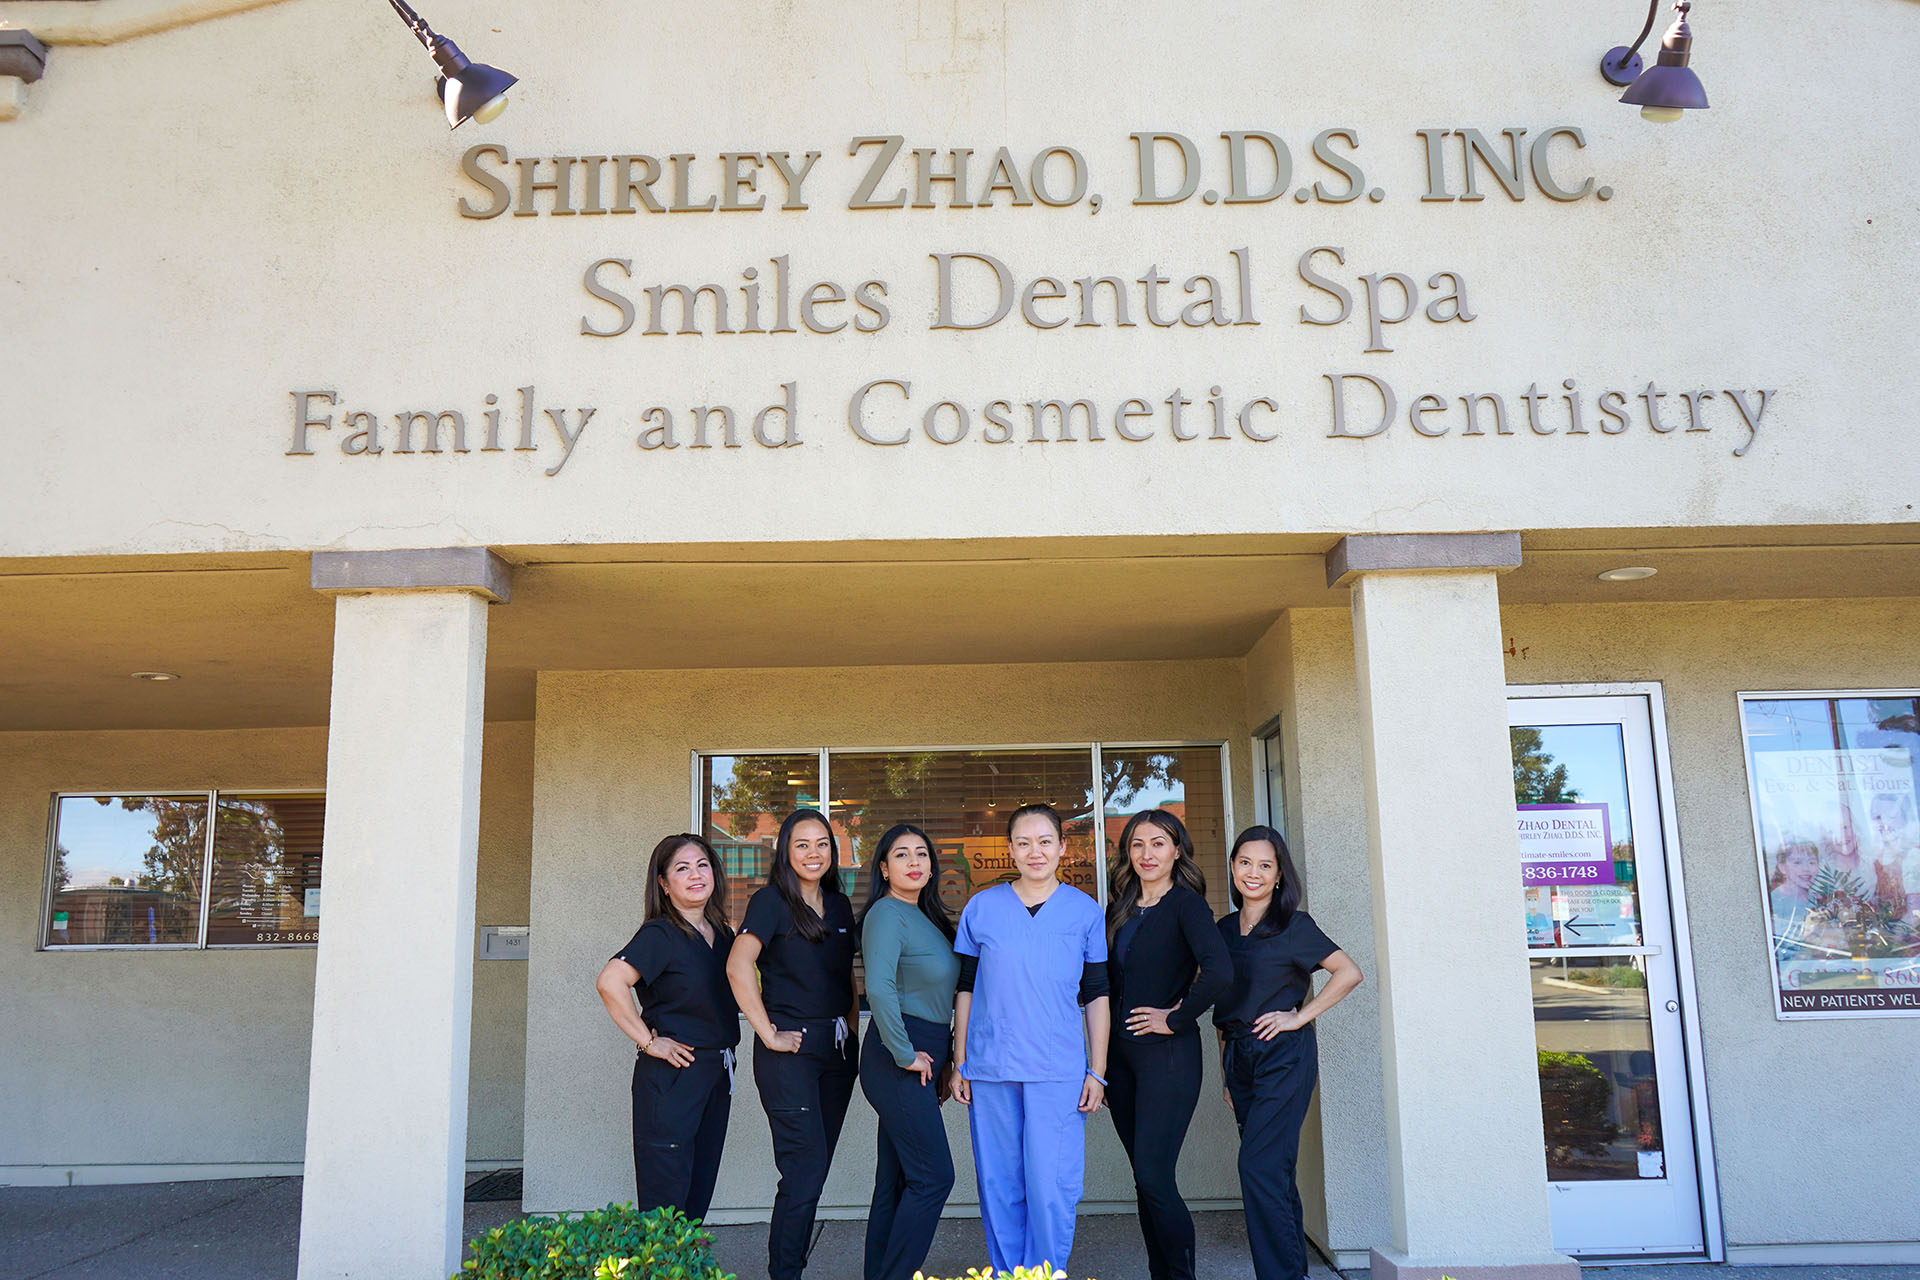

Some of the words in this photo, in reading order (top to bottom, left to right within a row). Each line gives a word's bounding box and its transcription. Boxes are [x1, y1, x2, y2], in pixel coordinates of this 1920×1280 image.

[458, 143, 822, 220] SHIRLEY
[848, 135, 1103, 215] ZHAO,
[1130, 127, 1386, 207] D.D.S.
[1416, 126, 1614, 203] INC.
[580, 254, 891, 337] Smiles
[929, 246, 1261, 331] Dental
[1298, 245, 1479, 353] Spa
[285, 385, 598, 477] Family
[637, 380, 804, 450] and
[847, 378, 1280, 446] Cosmetic
[1322, 373, 1777, 458] Dentistry
[1786, 754, 1882, 774] DENTIST
[1862, 775, 1910, 791] Hours
[1517, 820, 1549, 831] ZHAO
[1552, 819, 1597, 830] DENTAL
[257, 932, 319, 941] 832-8668
[1783, 996, 1815, 1008] NEW
[1821, 994, 1885, 1007] PATIENTS
